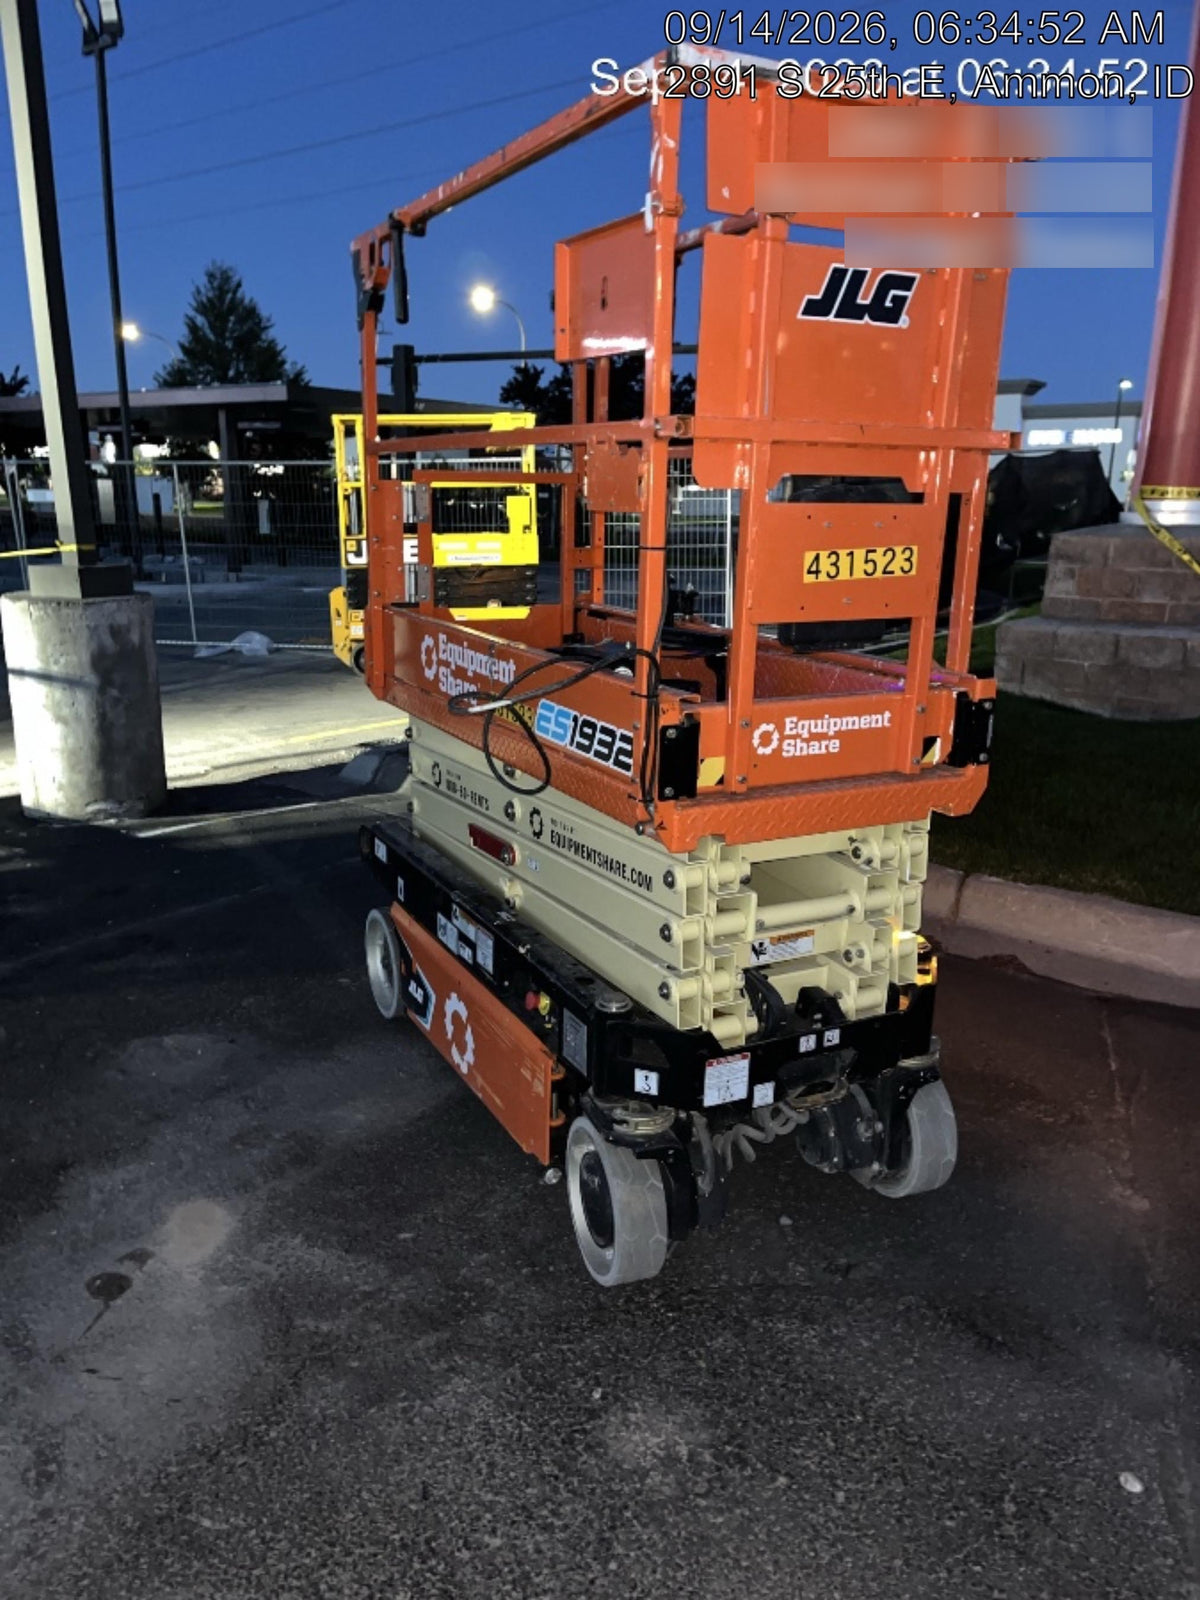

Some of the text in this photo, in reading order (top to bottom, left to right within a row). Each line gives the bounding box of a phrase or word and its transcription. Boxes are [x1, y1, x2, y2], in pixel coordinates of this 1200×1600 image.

[798, 263, 920, 328] JLG
[806, 547, 915, 580] 431523
[438, 633, 516, 685] Equipment
[534, 699, 634, 776] ES1932
[781, 739, 841, 757] Share
[783, 710, 892, 736] Equipment
[550, 829, 653, 893] EQUIPMENTSHARE.COM
